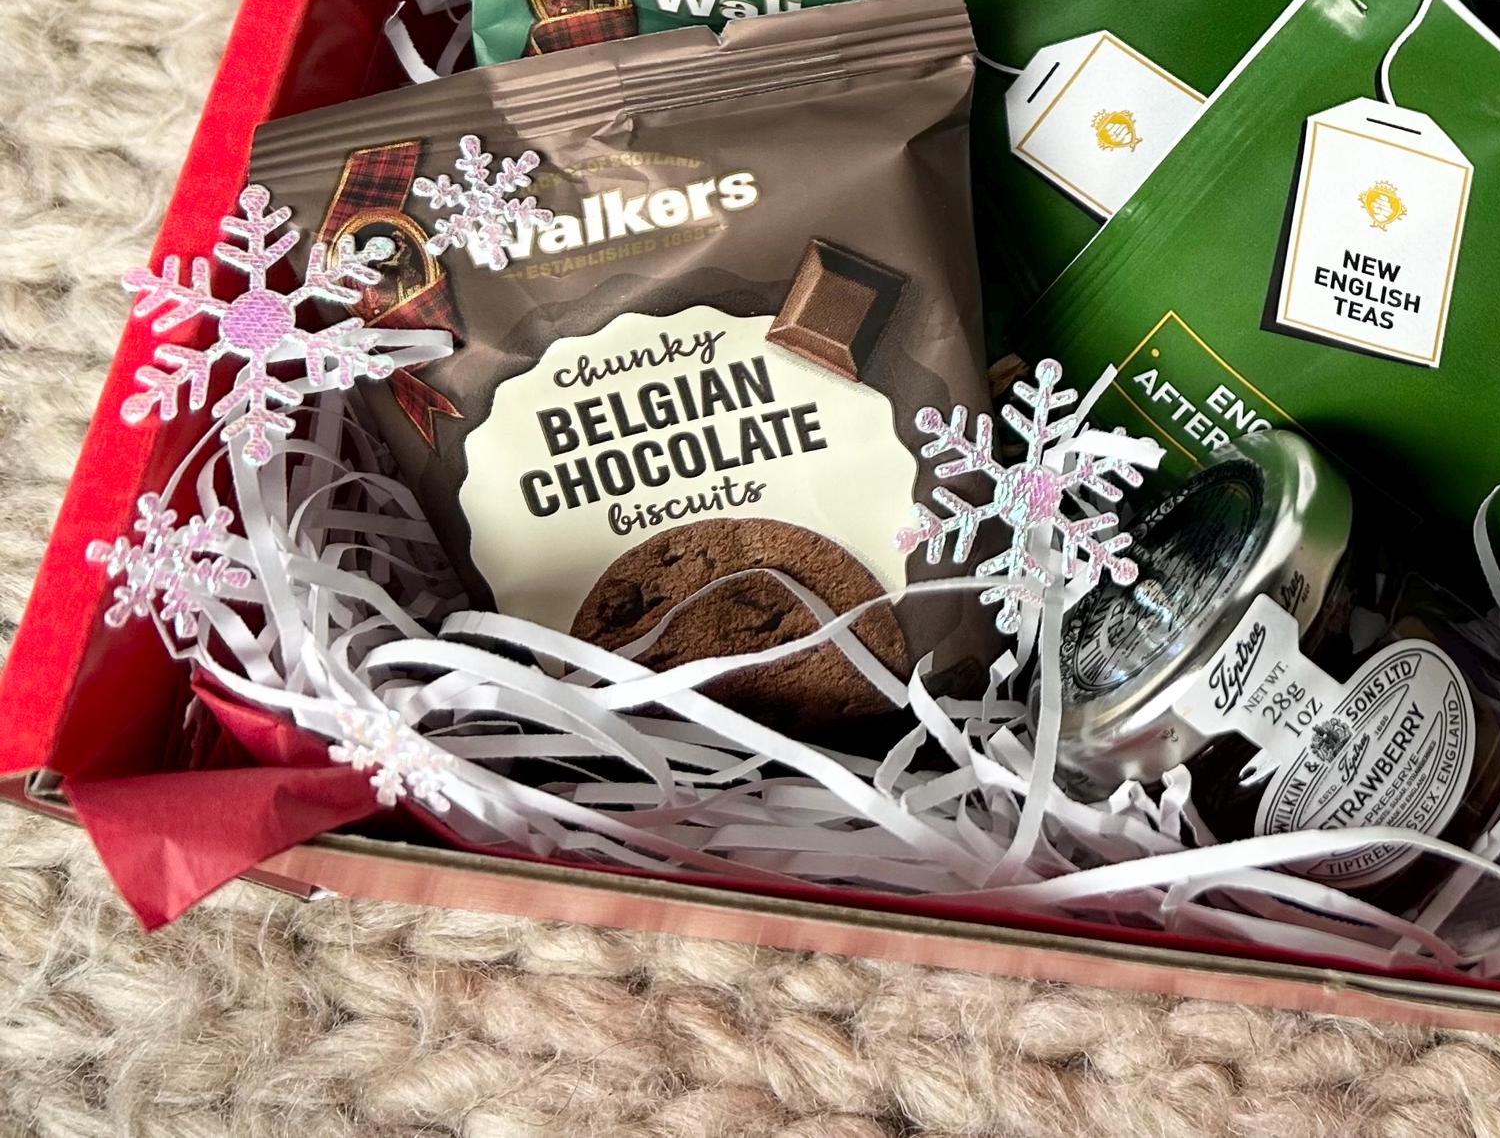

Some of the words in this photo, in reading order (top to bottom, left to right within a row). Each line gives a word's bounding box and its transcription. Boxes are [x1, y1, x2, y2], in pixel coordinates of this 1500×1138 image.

[527, 239, 657, 280] ESTABLISHED
[1313, 265, 1422, 314] ENGLISH
[1342, 249, 1401, 283] NEW
[1333, 295, 1395, 331] TEAS
[552, 329, 727, 388] chunky
[536, 354, 776, 458] BELGIAN
[1132, 368, 1232, 452] AFTER
[519, 400, 829, 518] CHOCOLATE
[607, 474, 767, 537] biscuits
[1208, 621, 1267, 717] Tiptree
[1242, 683, 1271, 713] NET
[1262, 680, 1307, 726] 28g
[1304, 760, 1320, 774] &
[1345, 679, 1386, 722] SONS
[1386, 659, 1413, 686] LTD
[1319, 700, 1426, 832] STRAWBERRY
[1364, 752, 1420, 823] PRESERVE
[1405, 790, 1441, 831] SSEX
[1436, 699, 1460, 786] ENGLAND
